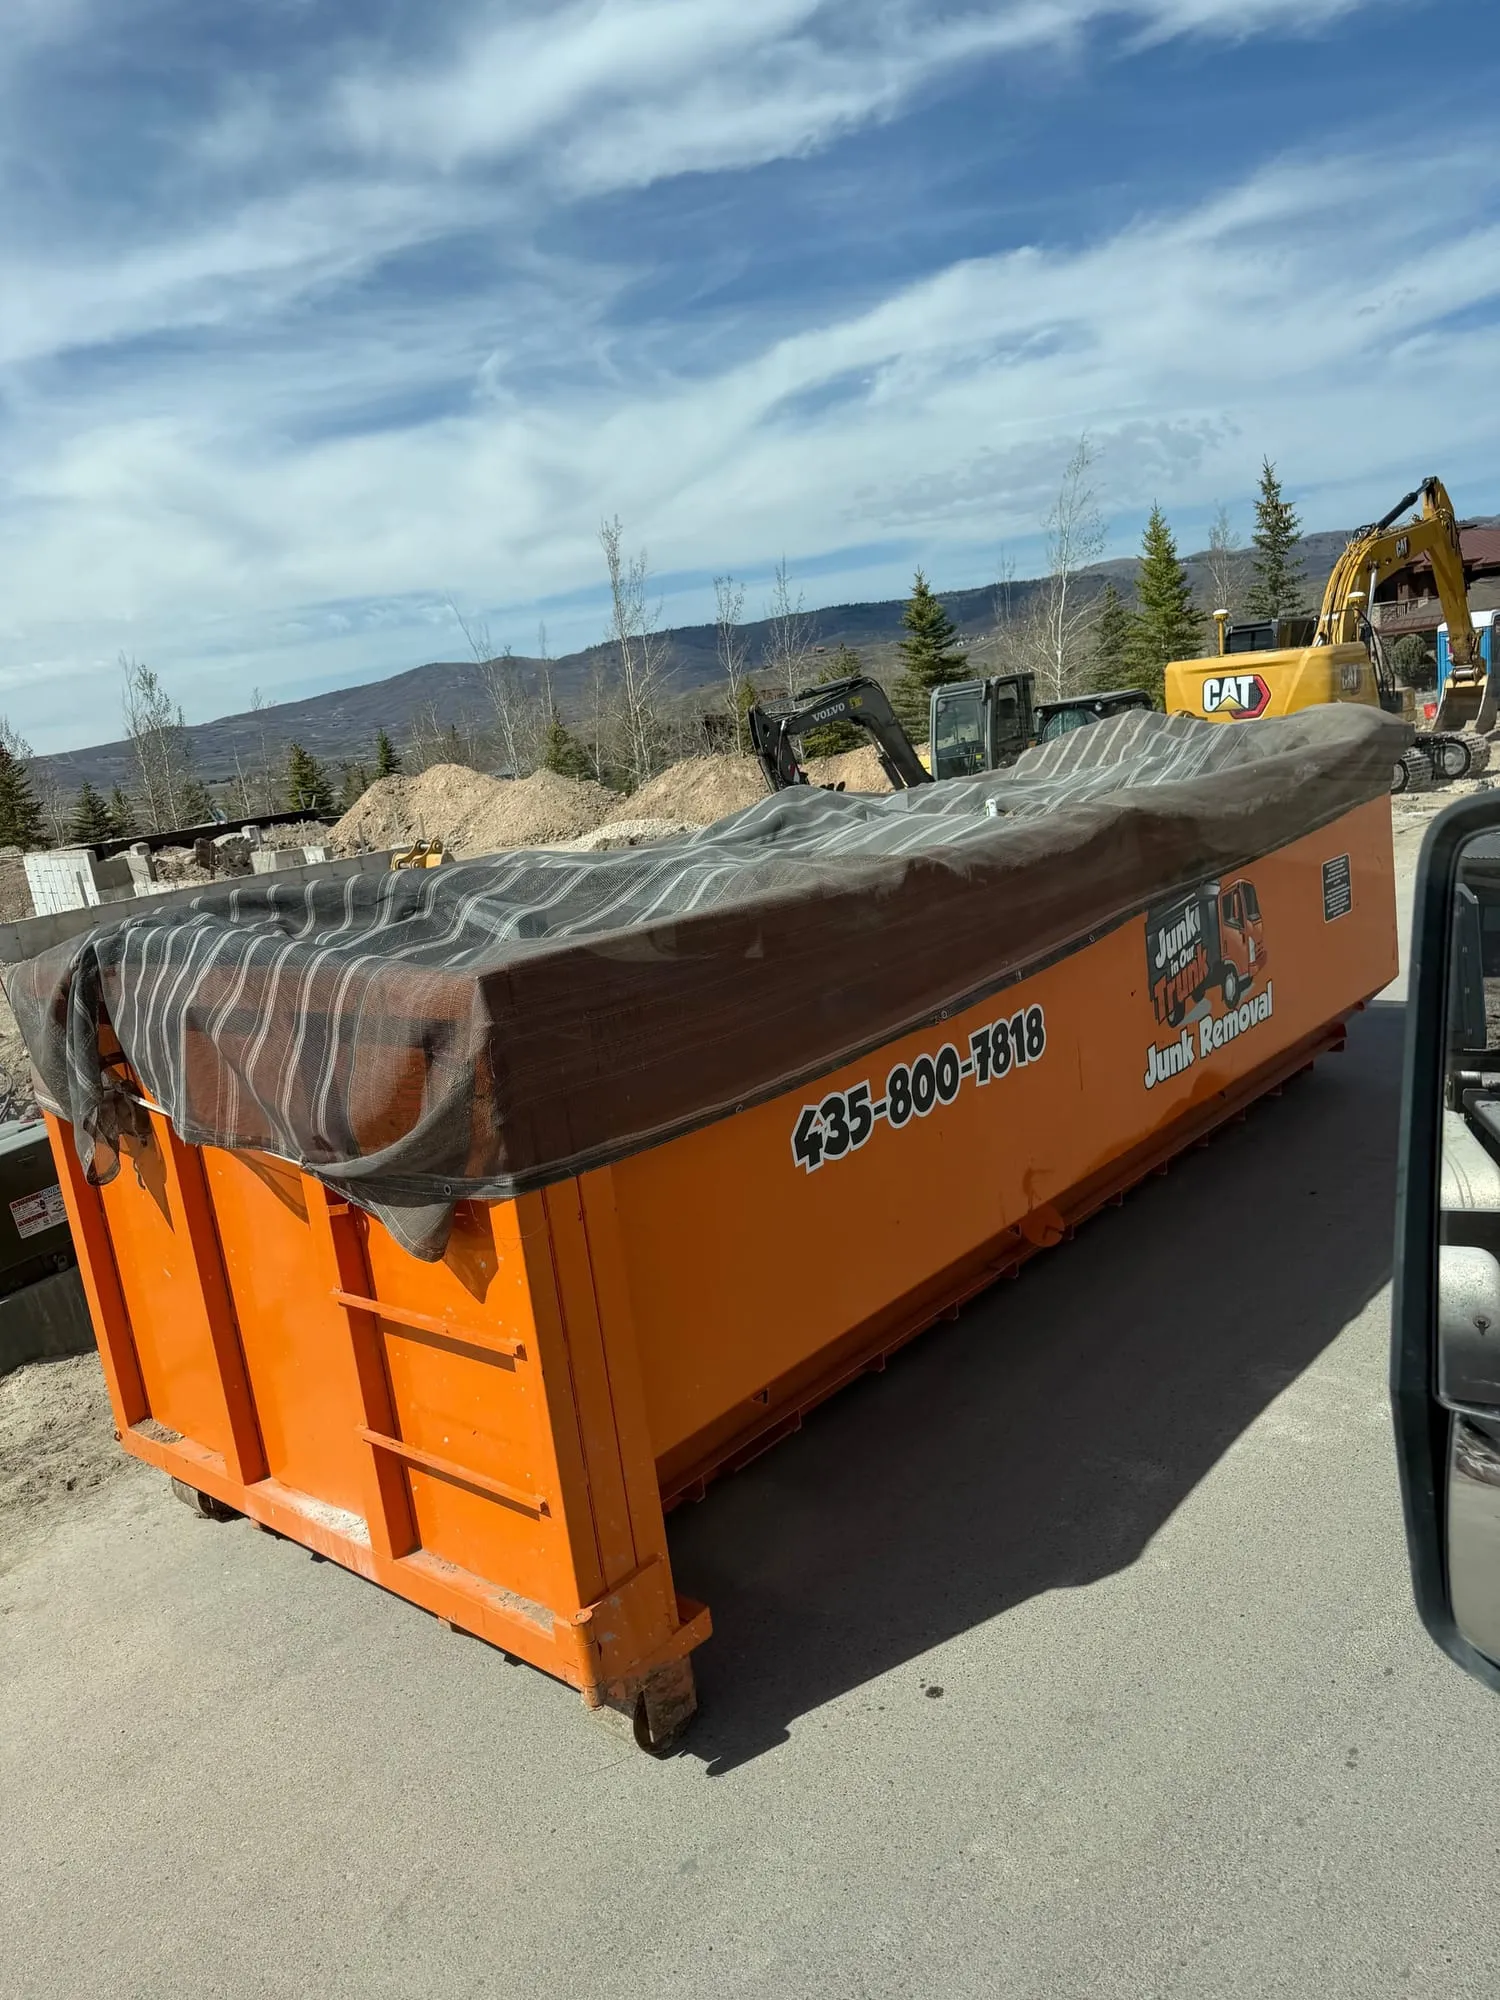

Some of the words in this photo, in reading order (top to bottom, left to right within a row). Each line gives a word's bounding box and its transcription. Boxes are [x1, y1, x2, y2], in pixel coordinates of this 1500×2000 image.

[1396, 536, 1408, 558] CAT
[1203, 675, 1254, 712] CAT
[1342, 664, 1358, 690] CAT
[811, 702, 845, 721] VOLVO
[1155, 905, 1200, 969] Junk
[1170, 960, 1180, 977] in
[1179, 942, 1197, 968] Our
[1154, 943, 1209, 1024] Trunk
[1144, 1026, 1196, 1089] Junk
[1199, 978, 1273, 1059] Removal
[790, 1003, 1047, 1175] 435-800-7818
